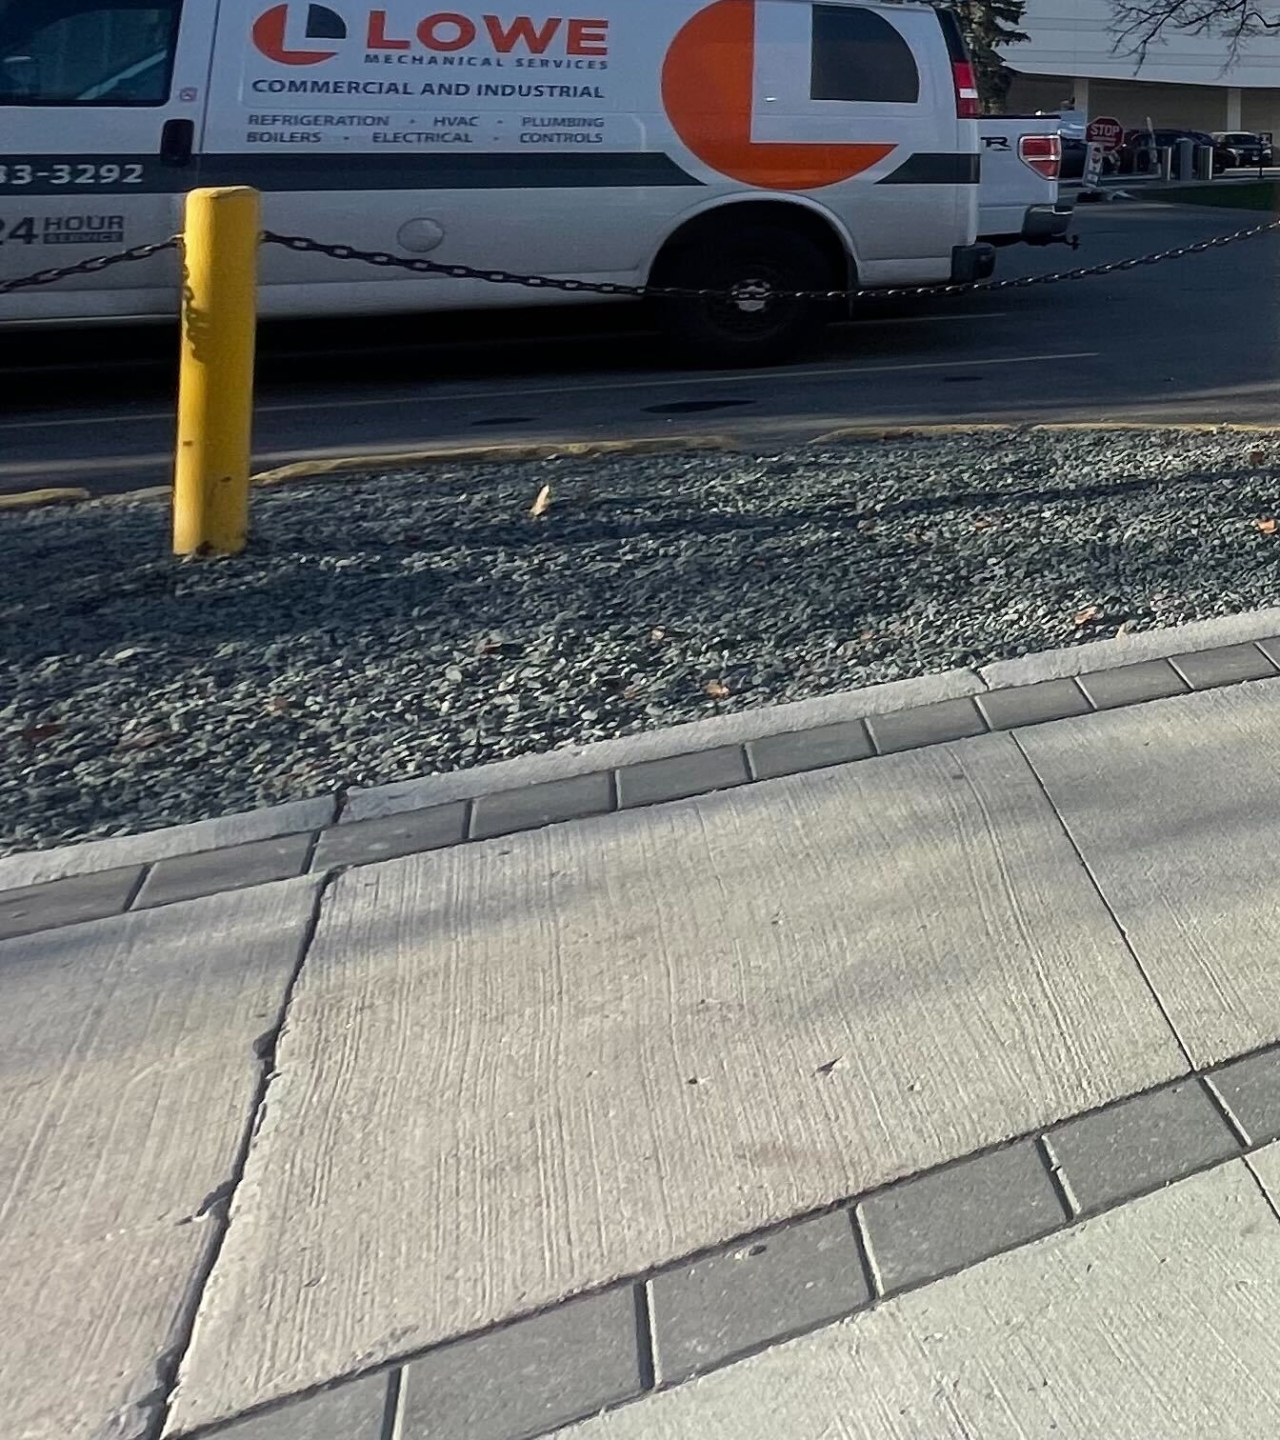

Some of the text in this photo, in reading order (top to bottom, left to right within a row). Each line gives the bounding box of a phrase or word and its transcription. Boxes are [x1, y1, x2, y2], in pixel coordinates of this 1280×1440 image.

[367, 10, 609, 56] LOWE
[364, 53, 608, 70] MECHANICAL SERVICES
[252, 79, 605, 98] COMMERCIAL AND INDUSTRIAL
[248, 114, 605, 128] REFRIGERATION HVAC PLUMBING
[246, 131, 603, 144] BOILERS ELECTRICAL CONTROLS
[1090, 124, 1120, 137] STOP
[44, 215, 124, 231] HOUR
